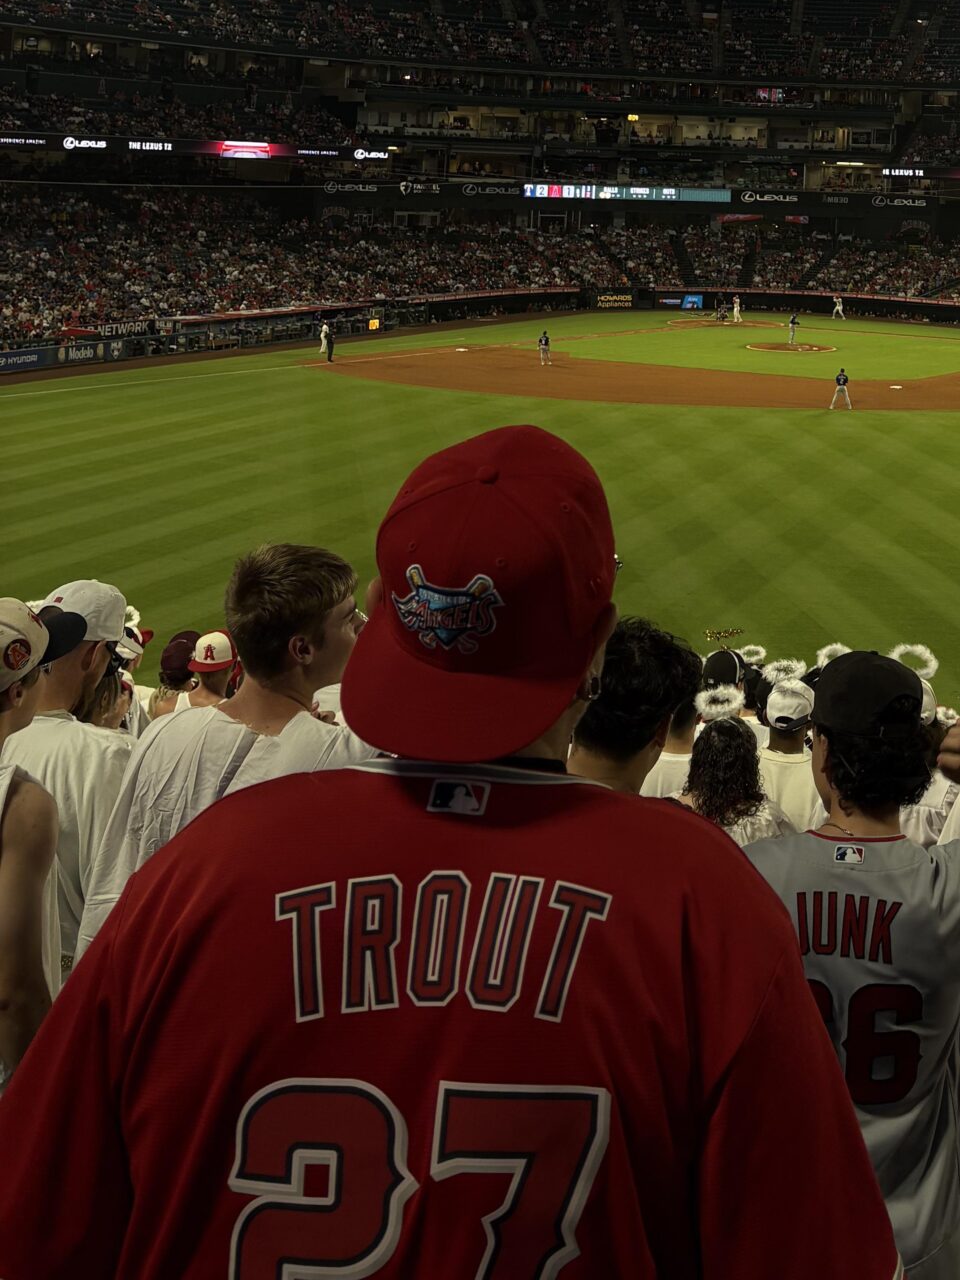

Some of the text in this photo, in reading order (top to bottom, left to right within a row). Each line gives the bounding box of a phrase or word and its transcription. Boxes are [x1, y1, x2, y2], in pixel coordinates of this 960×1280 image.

[75, 139, 107, 149] LEXUS
[128, 141, 173, 151] THE LEXUS TX
[891, 168, 914, 177] LEXUS
[914, 169, 924, 177] TX
[338, 183, 378, 192] LEXUS
[478, 187, 520, 195] LEXUS
[756, 193, 799, 202] LEXUS
[886, 198, 927, 207] LEXUS
[597, 300, 633, 308] Appliances
[98, 320, 150, 337] NETWORK
[68, 346, 94, 361] Modelo
[8, 354, 38, 365] HYUNDAI
[275, 870, 613, 1024] TROUT
[227, 1077, 612, 1280] 27
